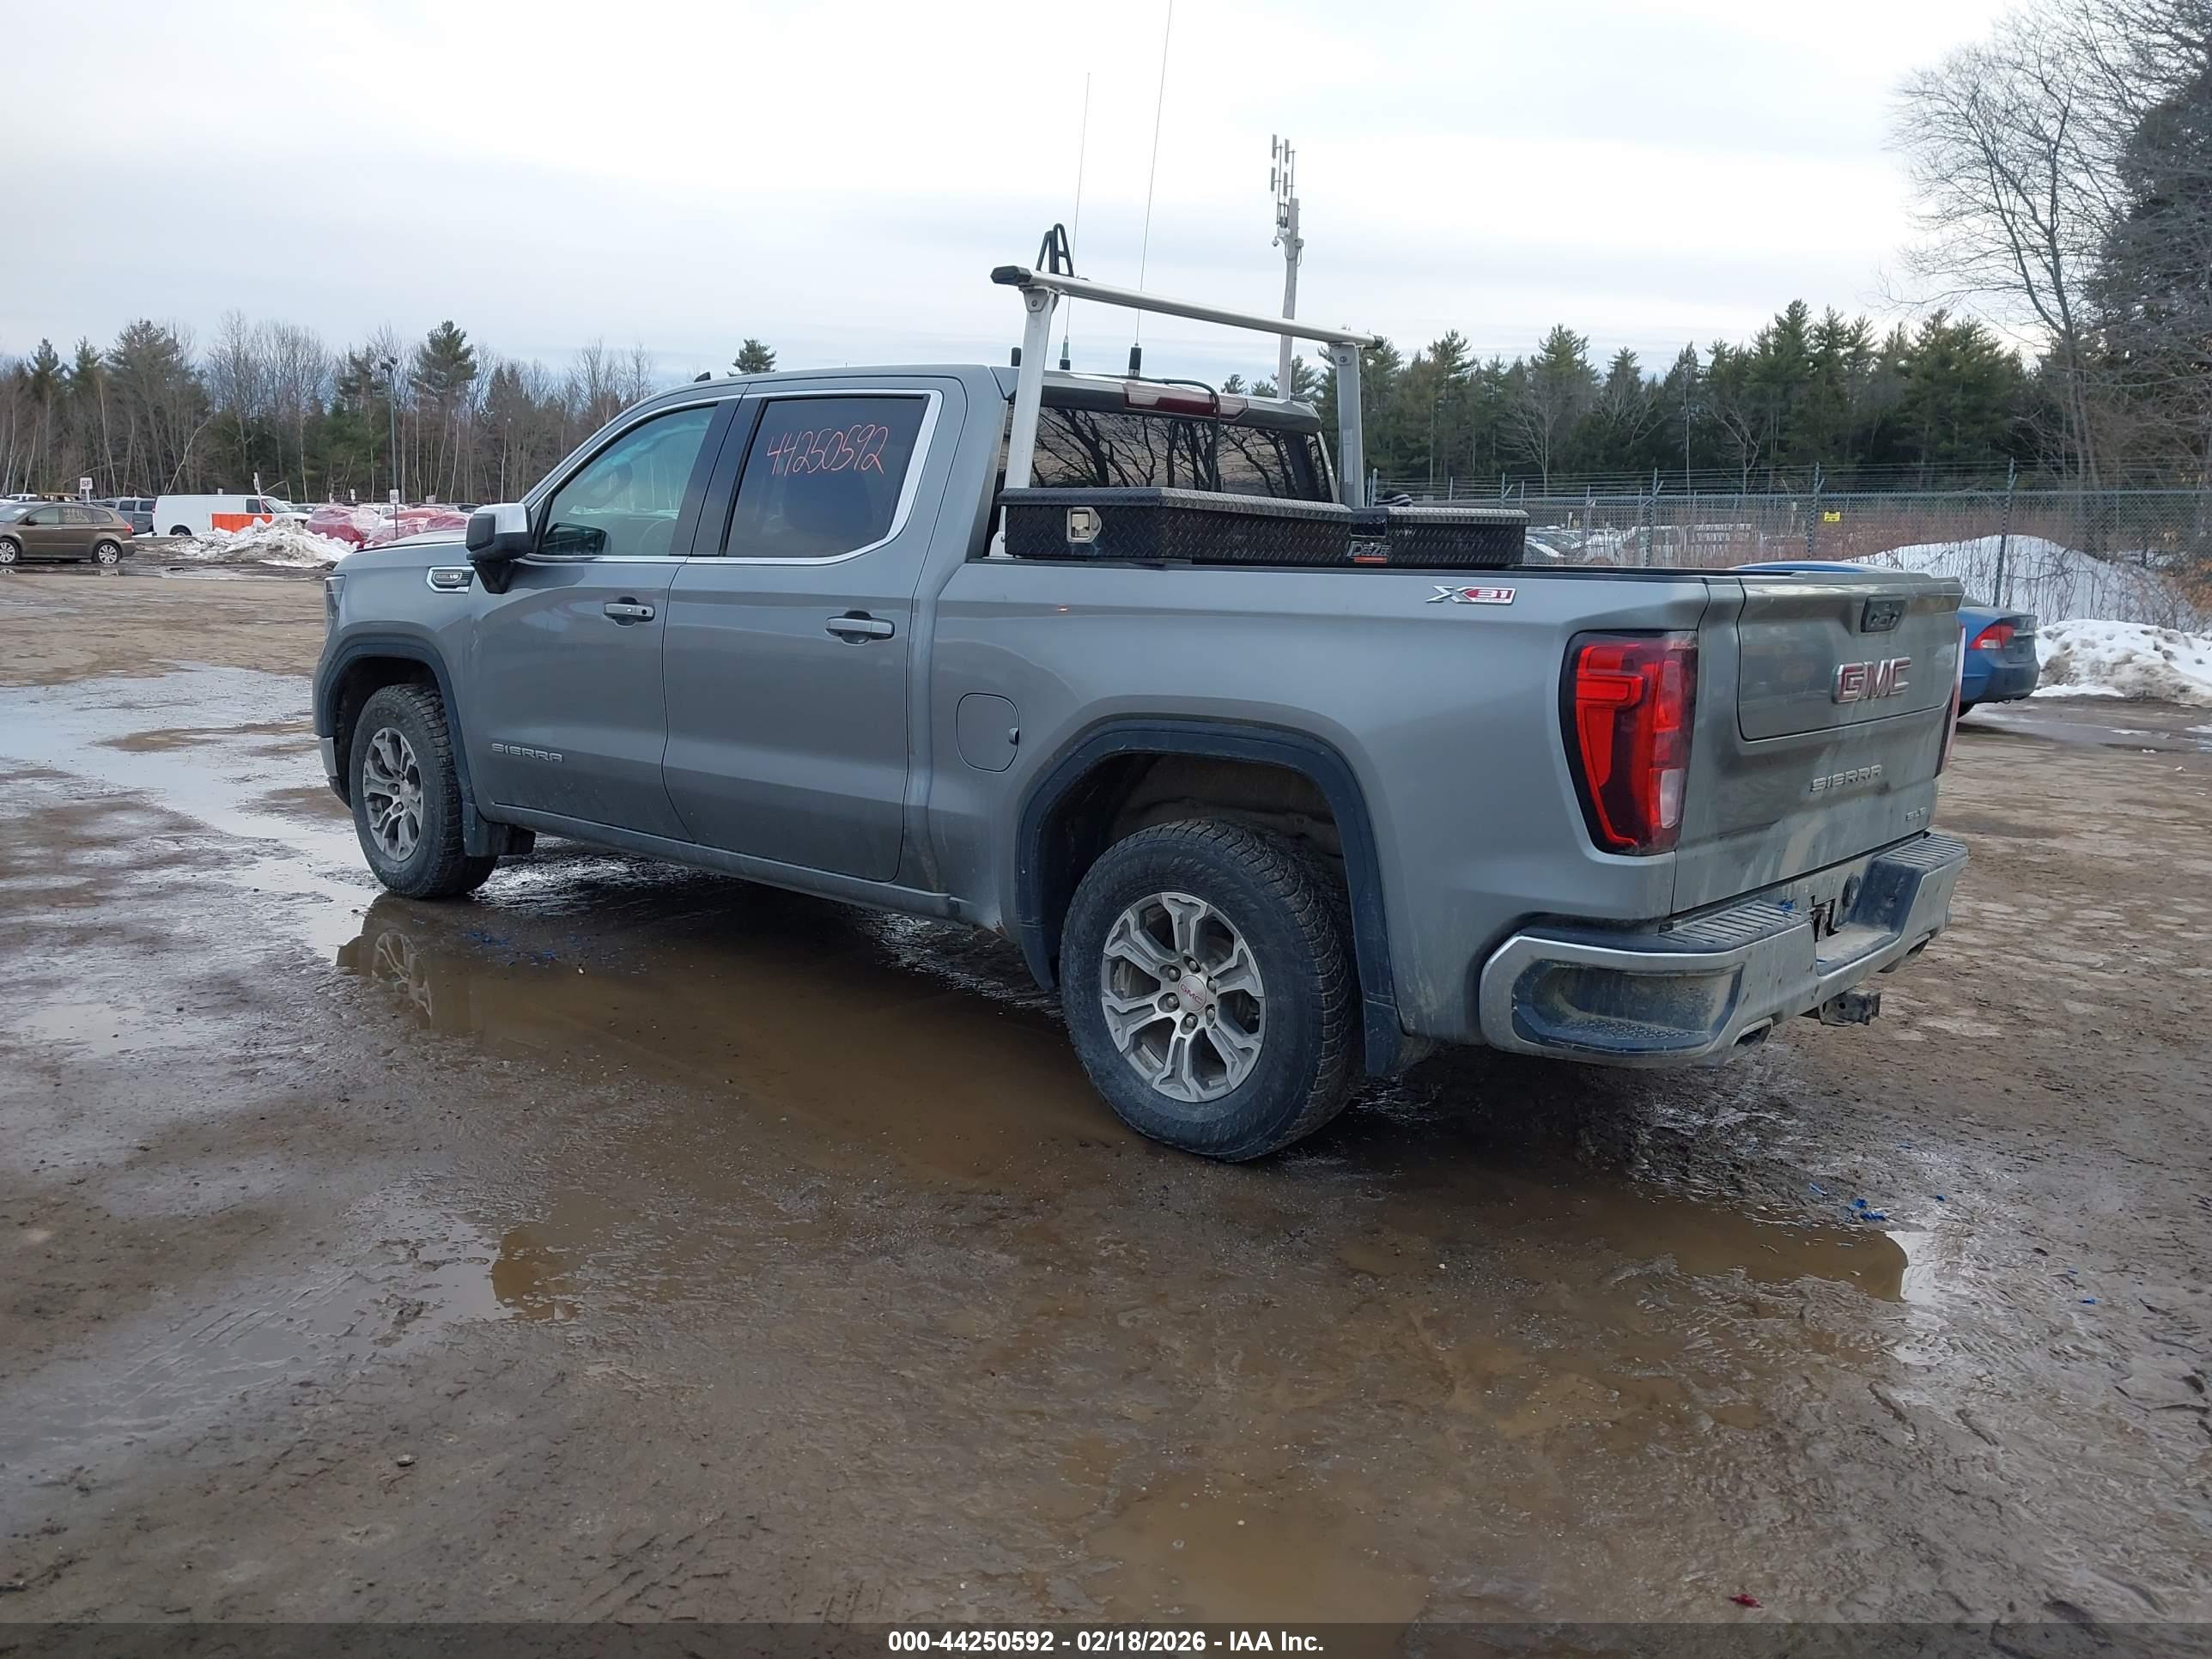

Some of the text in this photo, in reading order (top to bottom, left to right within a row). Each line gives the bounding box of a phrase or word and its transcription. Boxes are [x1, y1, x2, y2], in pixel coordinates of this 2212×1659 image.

[767, 423, 889, 477] 44250592
[1832, 656, 1911, 704] GMC
[491, 743, 563, 763] SIERRA
[1810, 764, 1883, 792] SIERRA
[1180, 983, 1203, 1006] GMC
